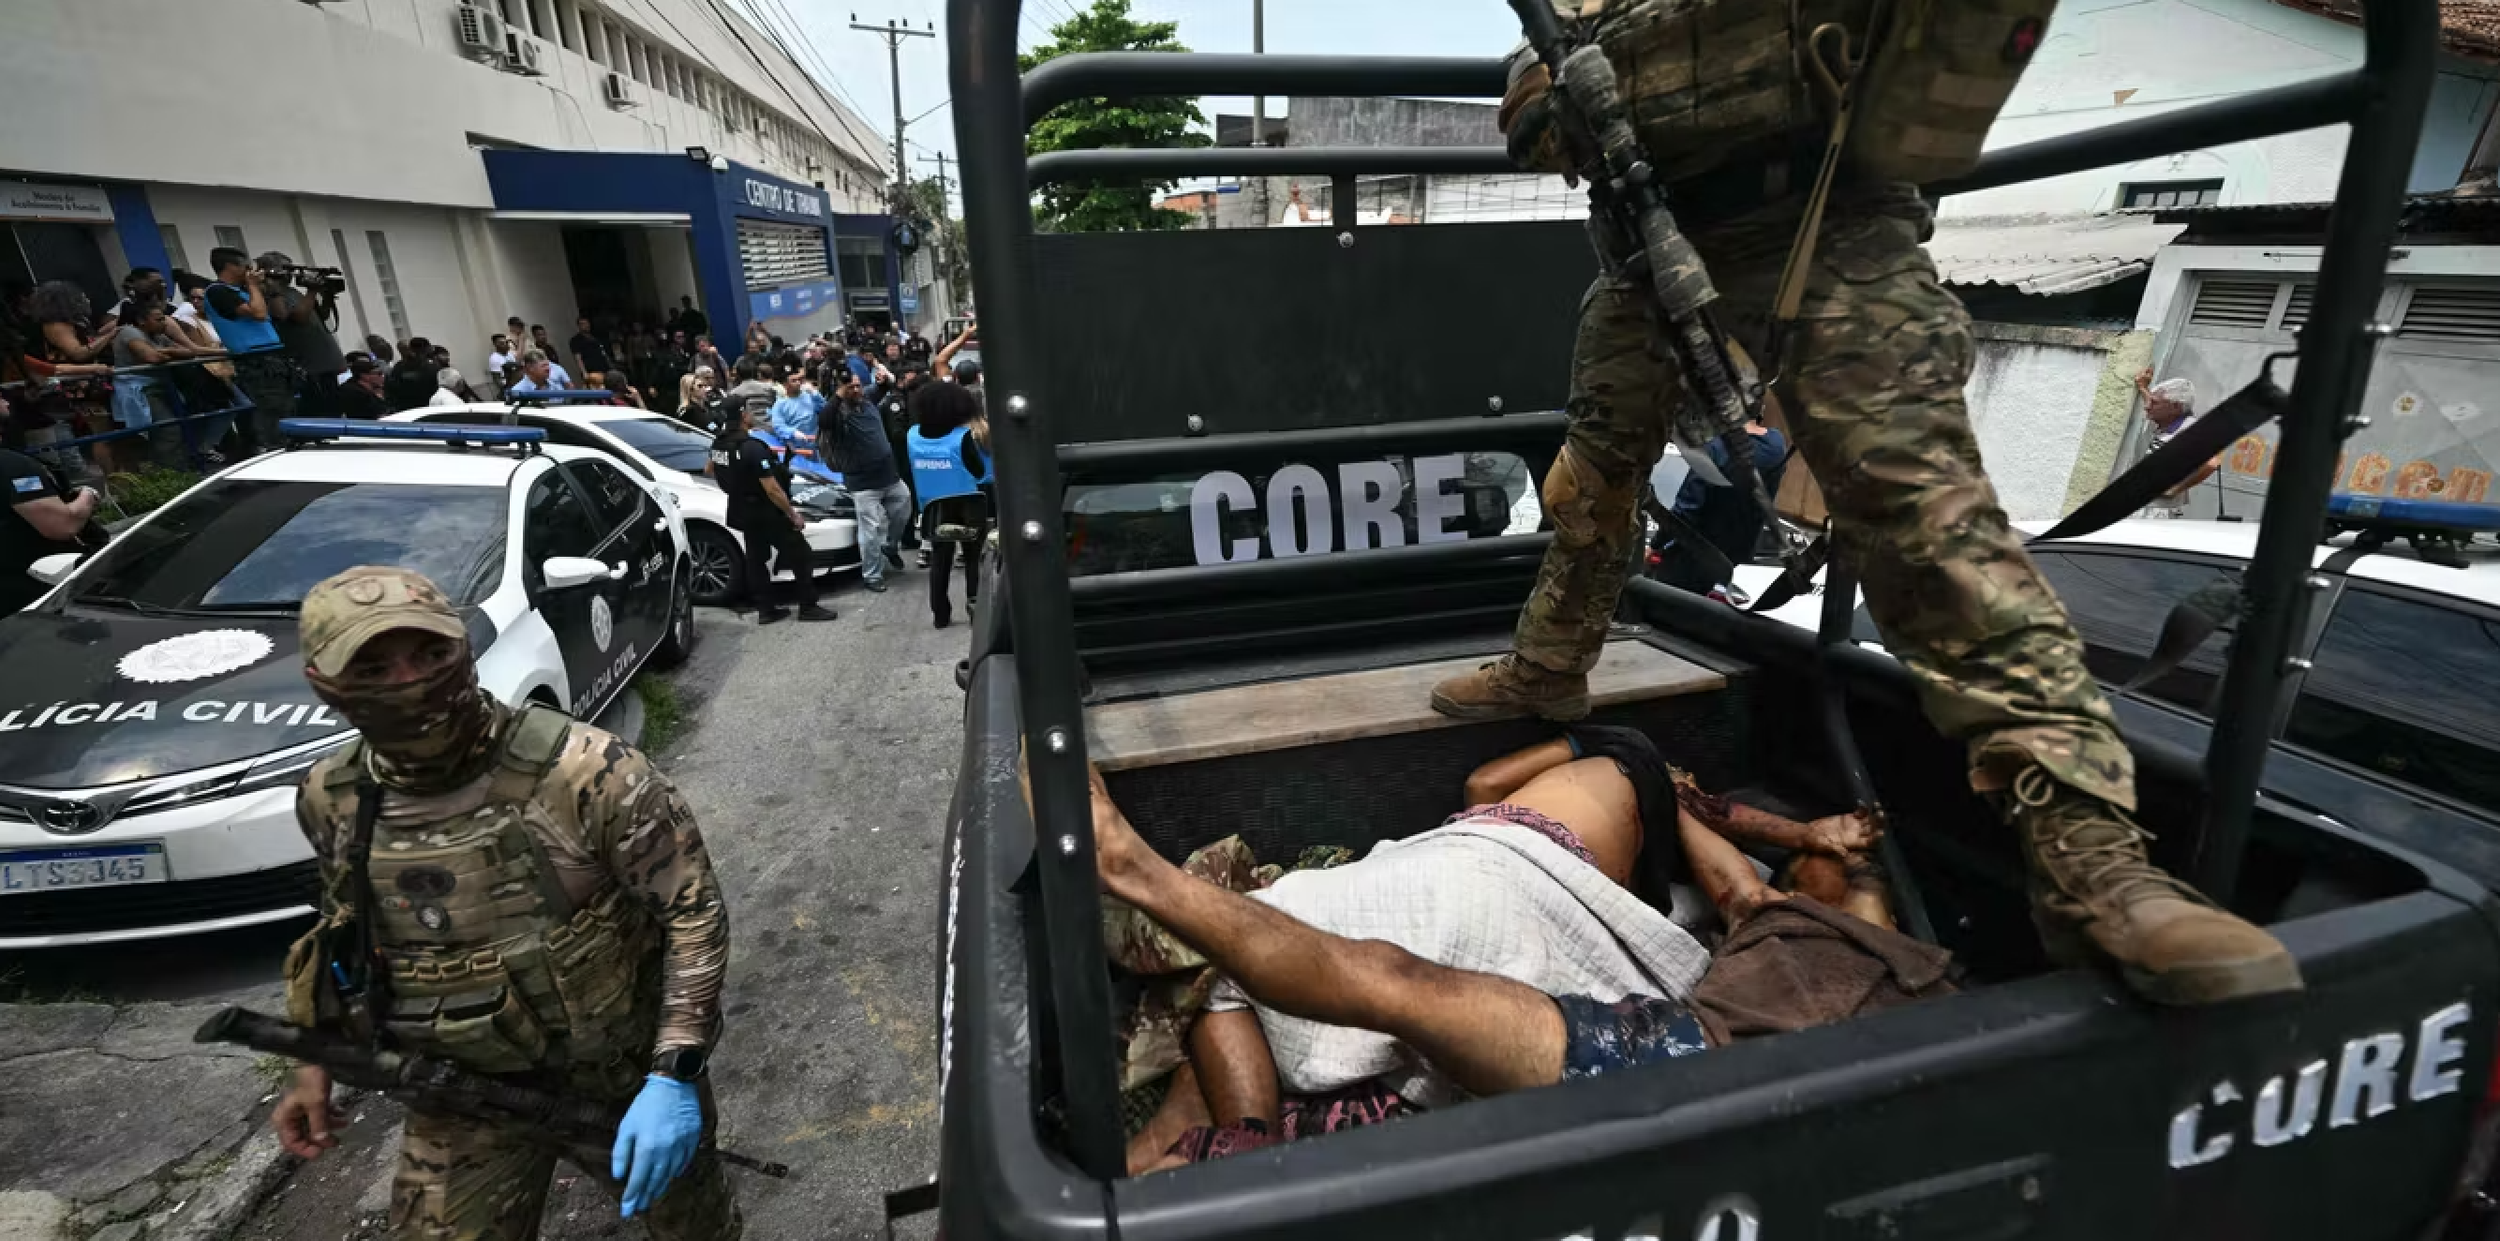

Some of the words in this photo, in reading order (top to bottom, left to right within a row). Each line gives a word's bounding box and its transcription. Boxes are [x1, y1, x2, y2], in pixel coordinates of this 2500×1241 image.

[745, 178, 782, 210] CENTRO
[783, 188, 796, 213] DE
[1190, 455, 1468, 564] CORE
[183, 701, 338, 726] CIVIL
